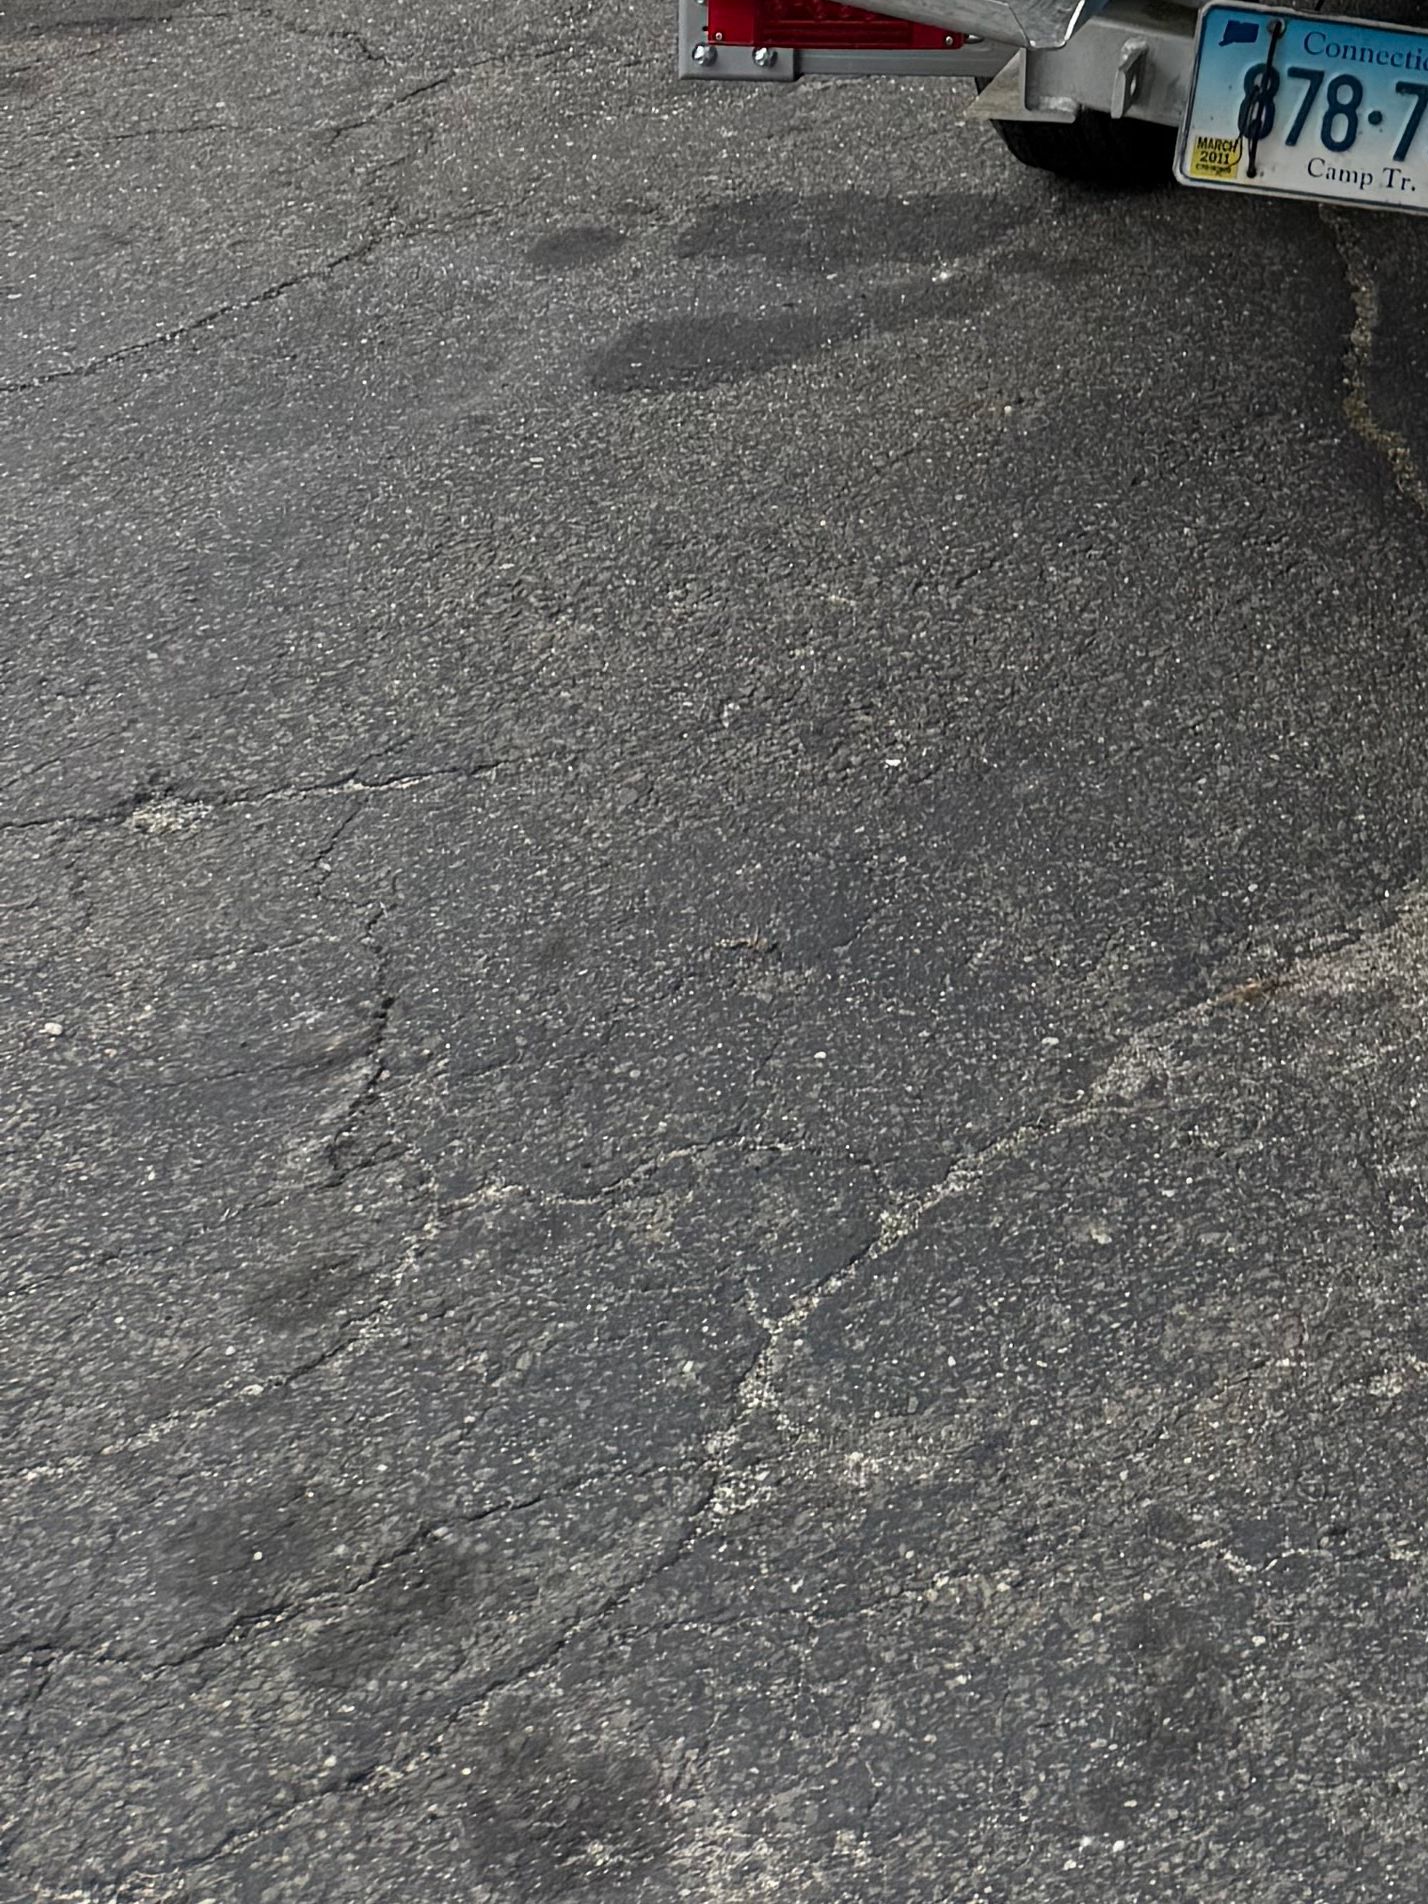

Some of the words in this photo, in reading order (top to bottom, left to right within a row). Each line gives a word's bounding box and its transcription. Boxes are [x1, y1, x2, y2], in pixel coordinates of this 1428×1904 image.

[1199, 150, 1230, 165] 2011
[1307, 157, 1374, 190] Camp
[1382, 167, 1416, 192] Tr.
